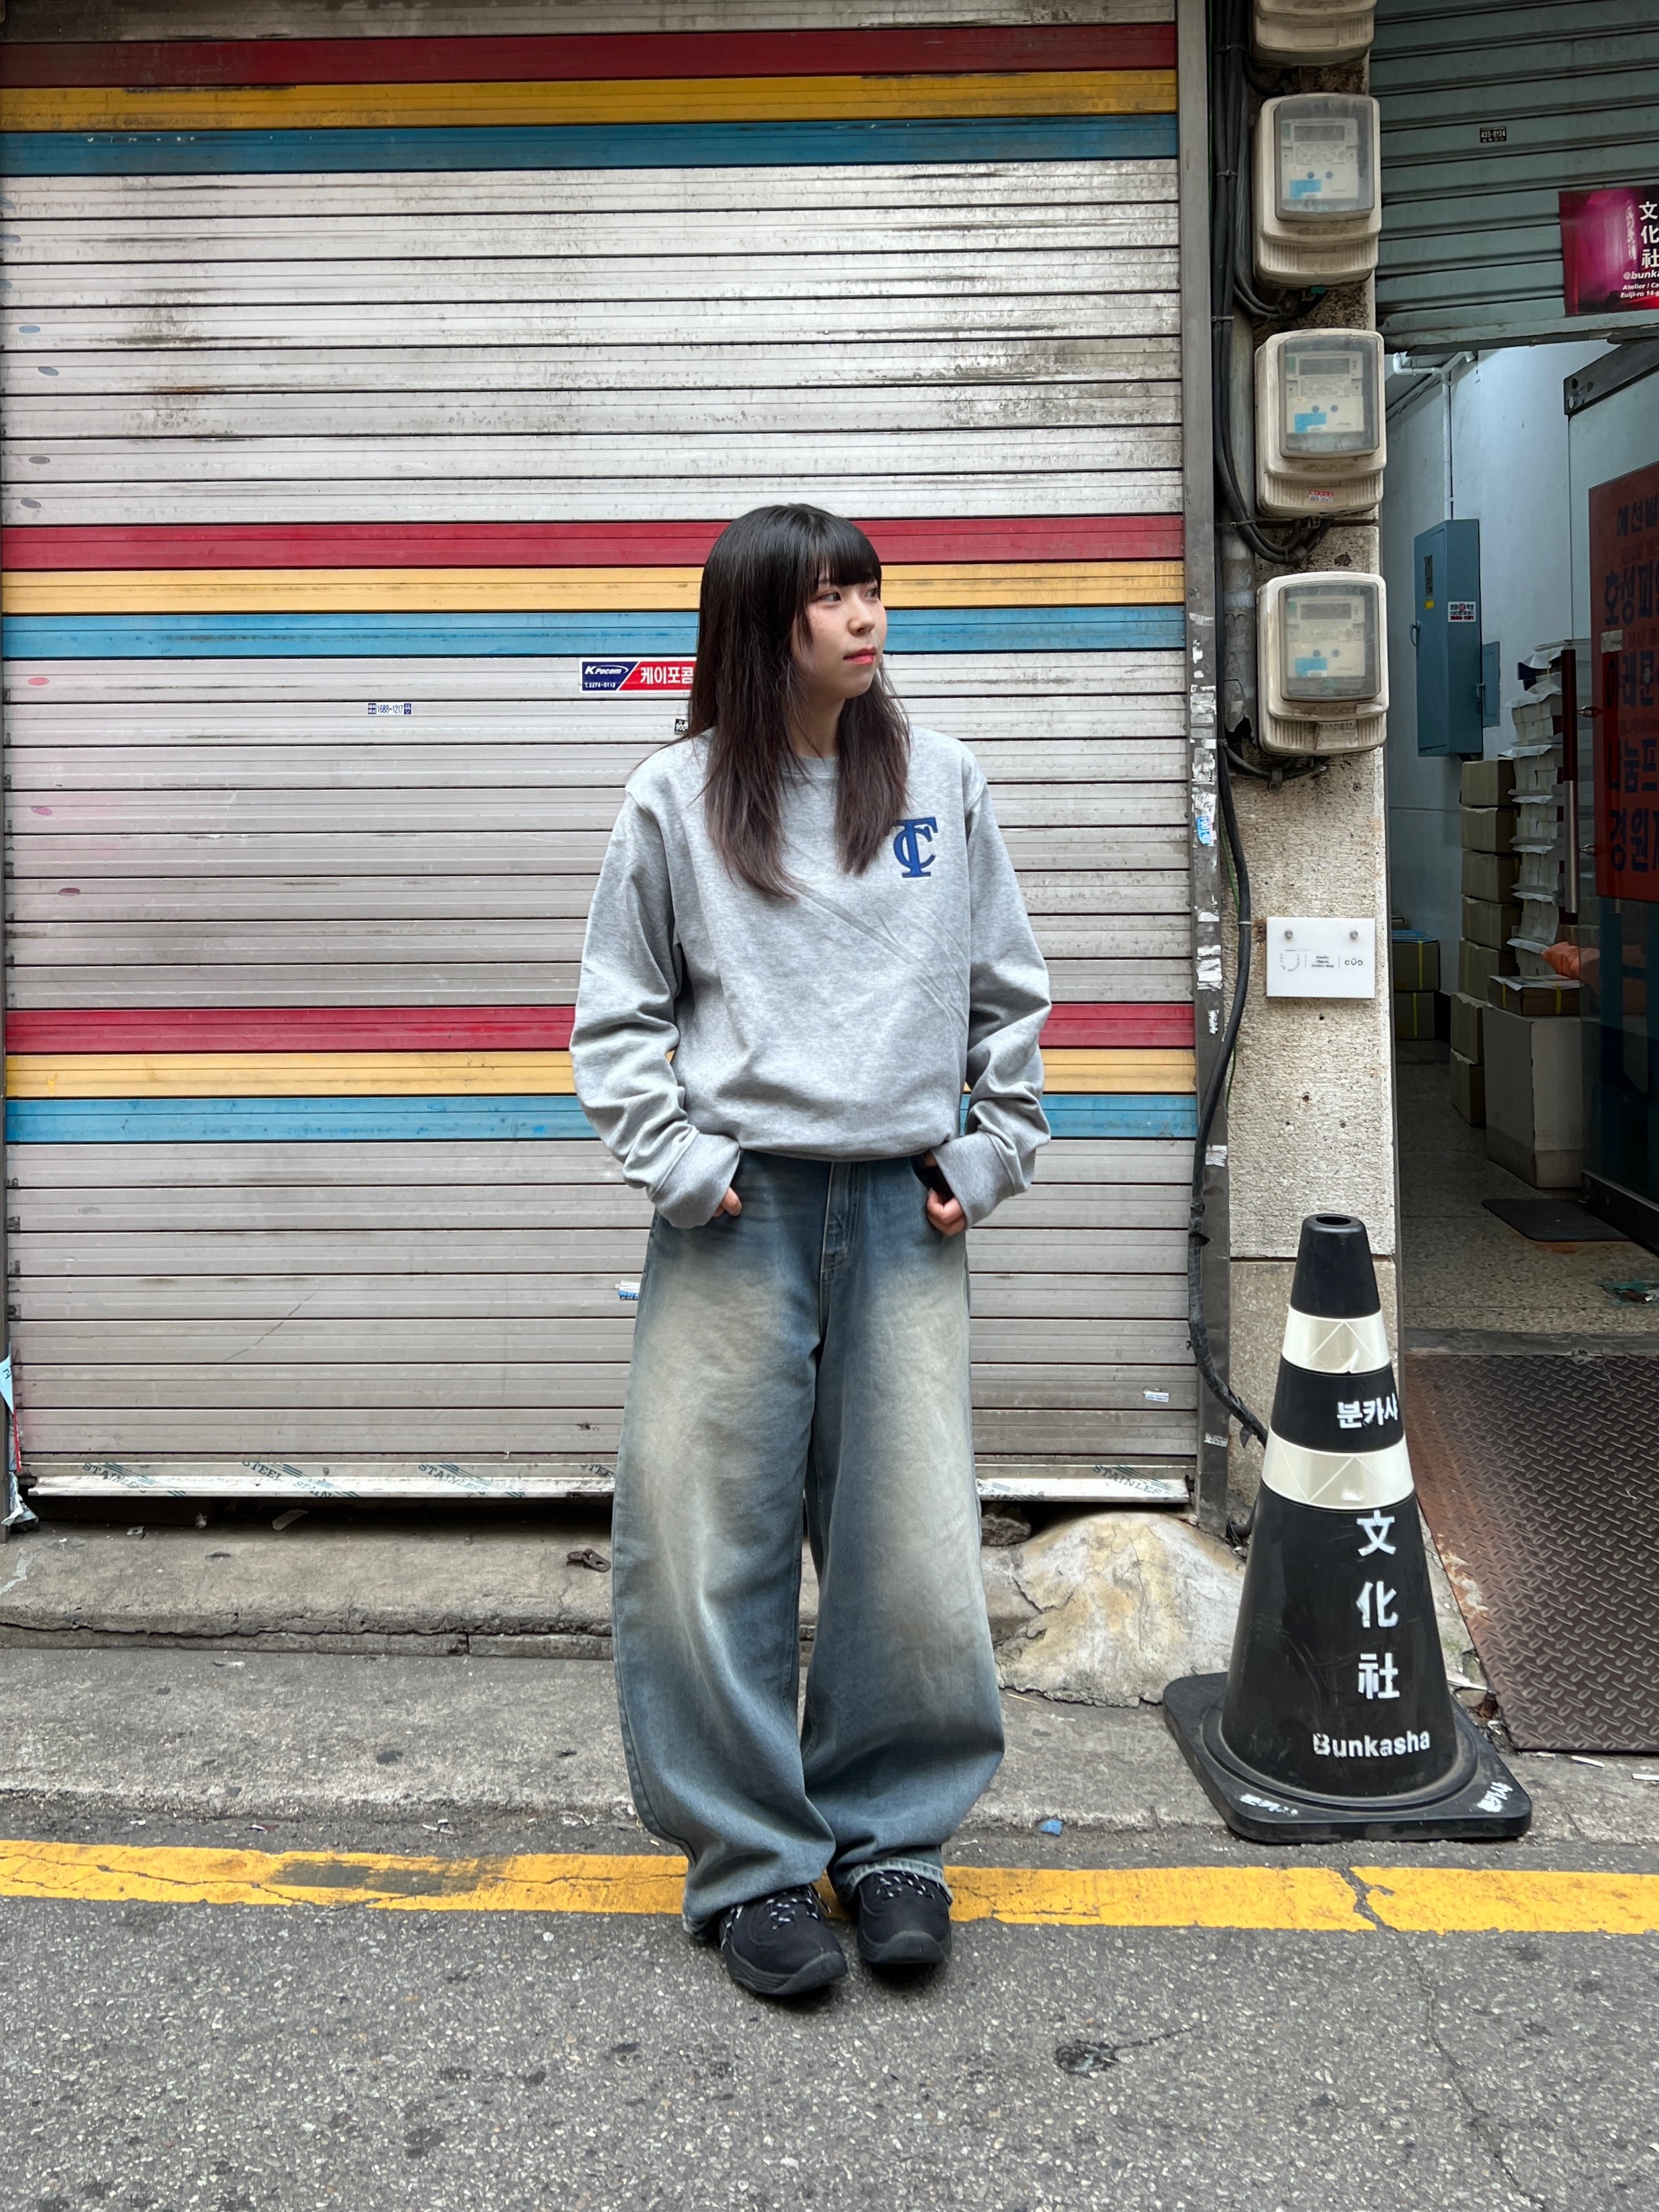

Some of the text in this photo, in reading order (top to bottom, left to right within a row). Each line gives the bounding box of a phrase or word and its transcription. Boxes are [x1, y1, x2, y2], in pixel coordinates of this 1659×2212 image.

[1639, 201, 1659, 268] 文化社
[1605, 560, 1659, 626] 호성피
[1337, 1393, 1398, 1429] 분카사
[1356, 1509, 1400, 1700] 文化社
[1313, 1730, 1431, 1758] Bunkasha
